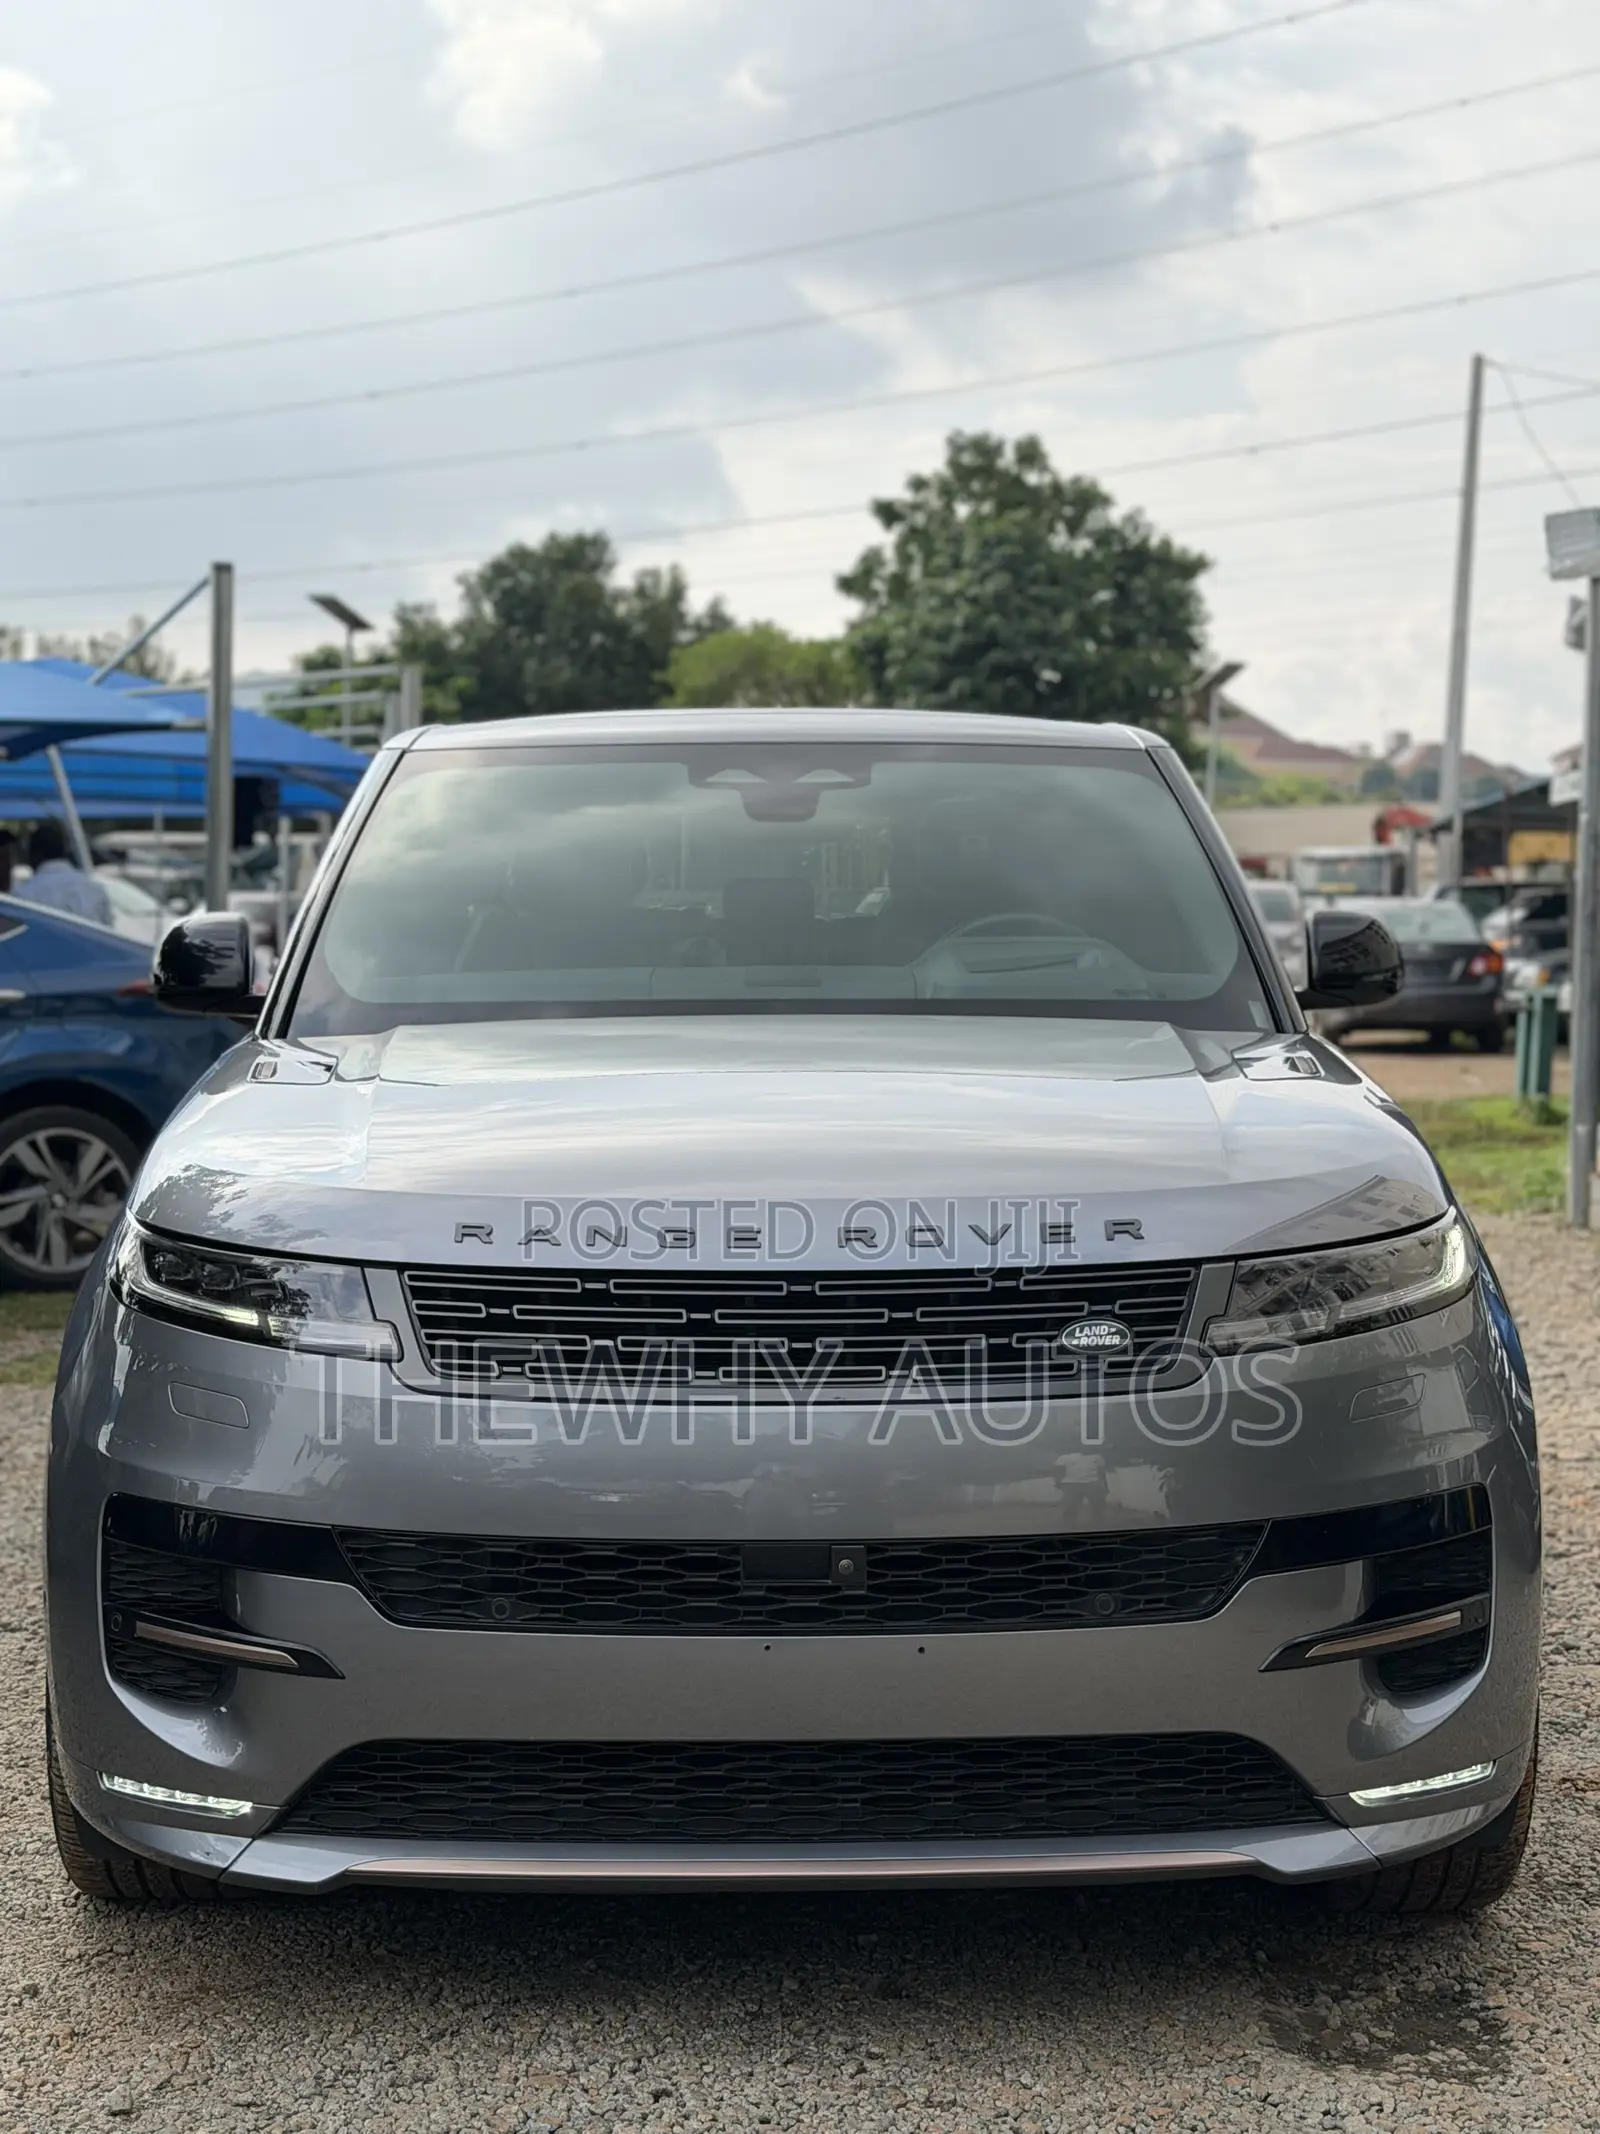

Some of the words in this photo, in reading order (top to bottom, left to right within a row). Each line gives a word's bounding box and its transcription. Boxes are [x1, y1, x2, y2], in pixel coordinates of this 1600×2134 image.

[453, 1221, 762, 1249] RANGE
[837, 1218, 1145, 1248] ROVER
[1075, 1325, 1109, 1337] LAND
[1080, 1335, 1121, 1347] ROVER
